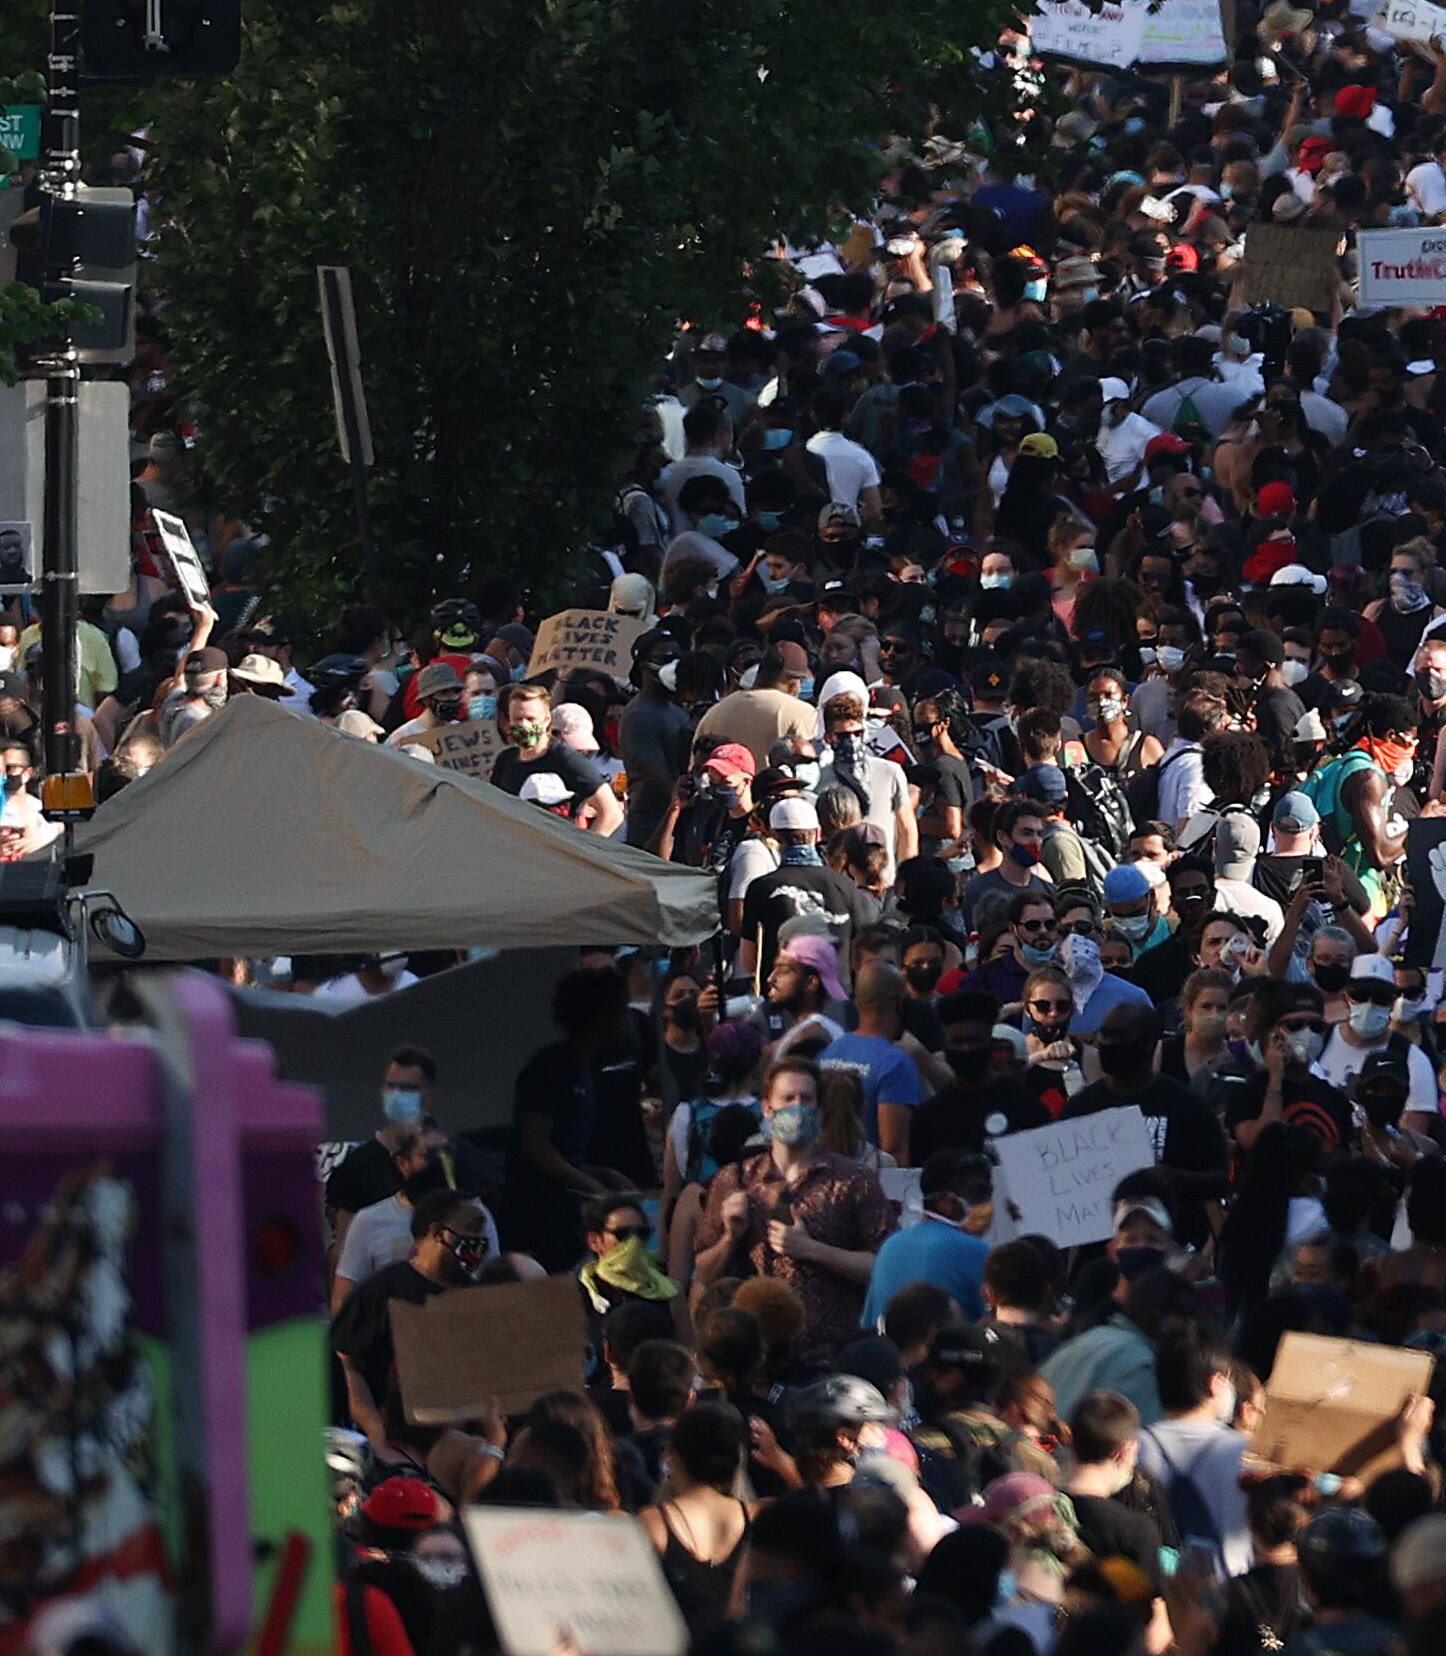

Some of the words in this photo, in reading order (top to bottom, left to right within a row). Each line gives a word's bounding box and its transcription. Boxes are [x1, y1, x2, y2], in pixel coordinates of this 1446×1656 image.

[0, 114, 23, 132] ST
[537, 648, 618, 666] MATTER
[433, 729, 491, 757] JEWS
[1038, 1120, 1130, 1171] BLACK
[1050, 1160, 1115, 1197] LIVES
